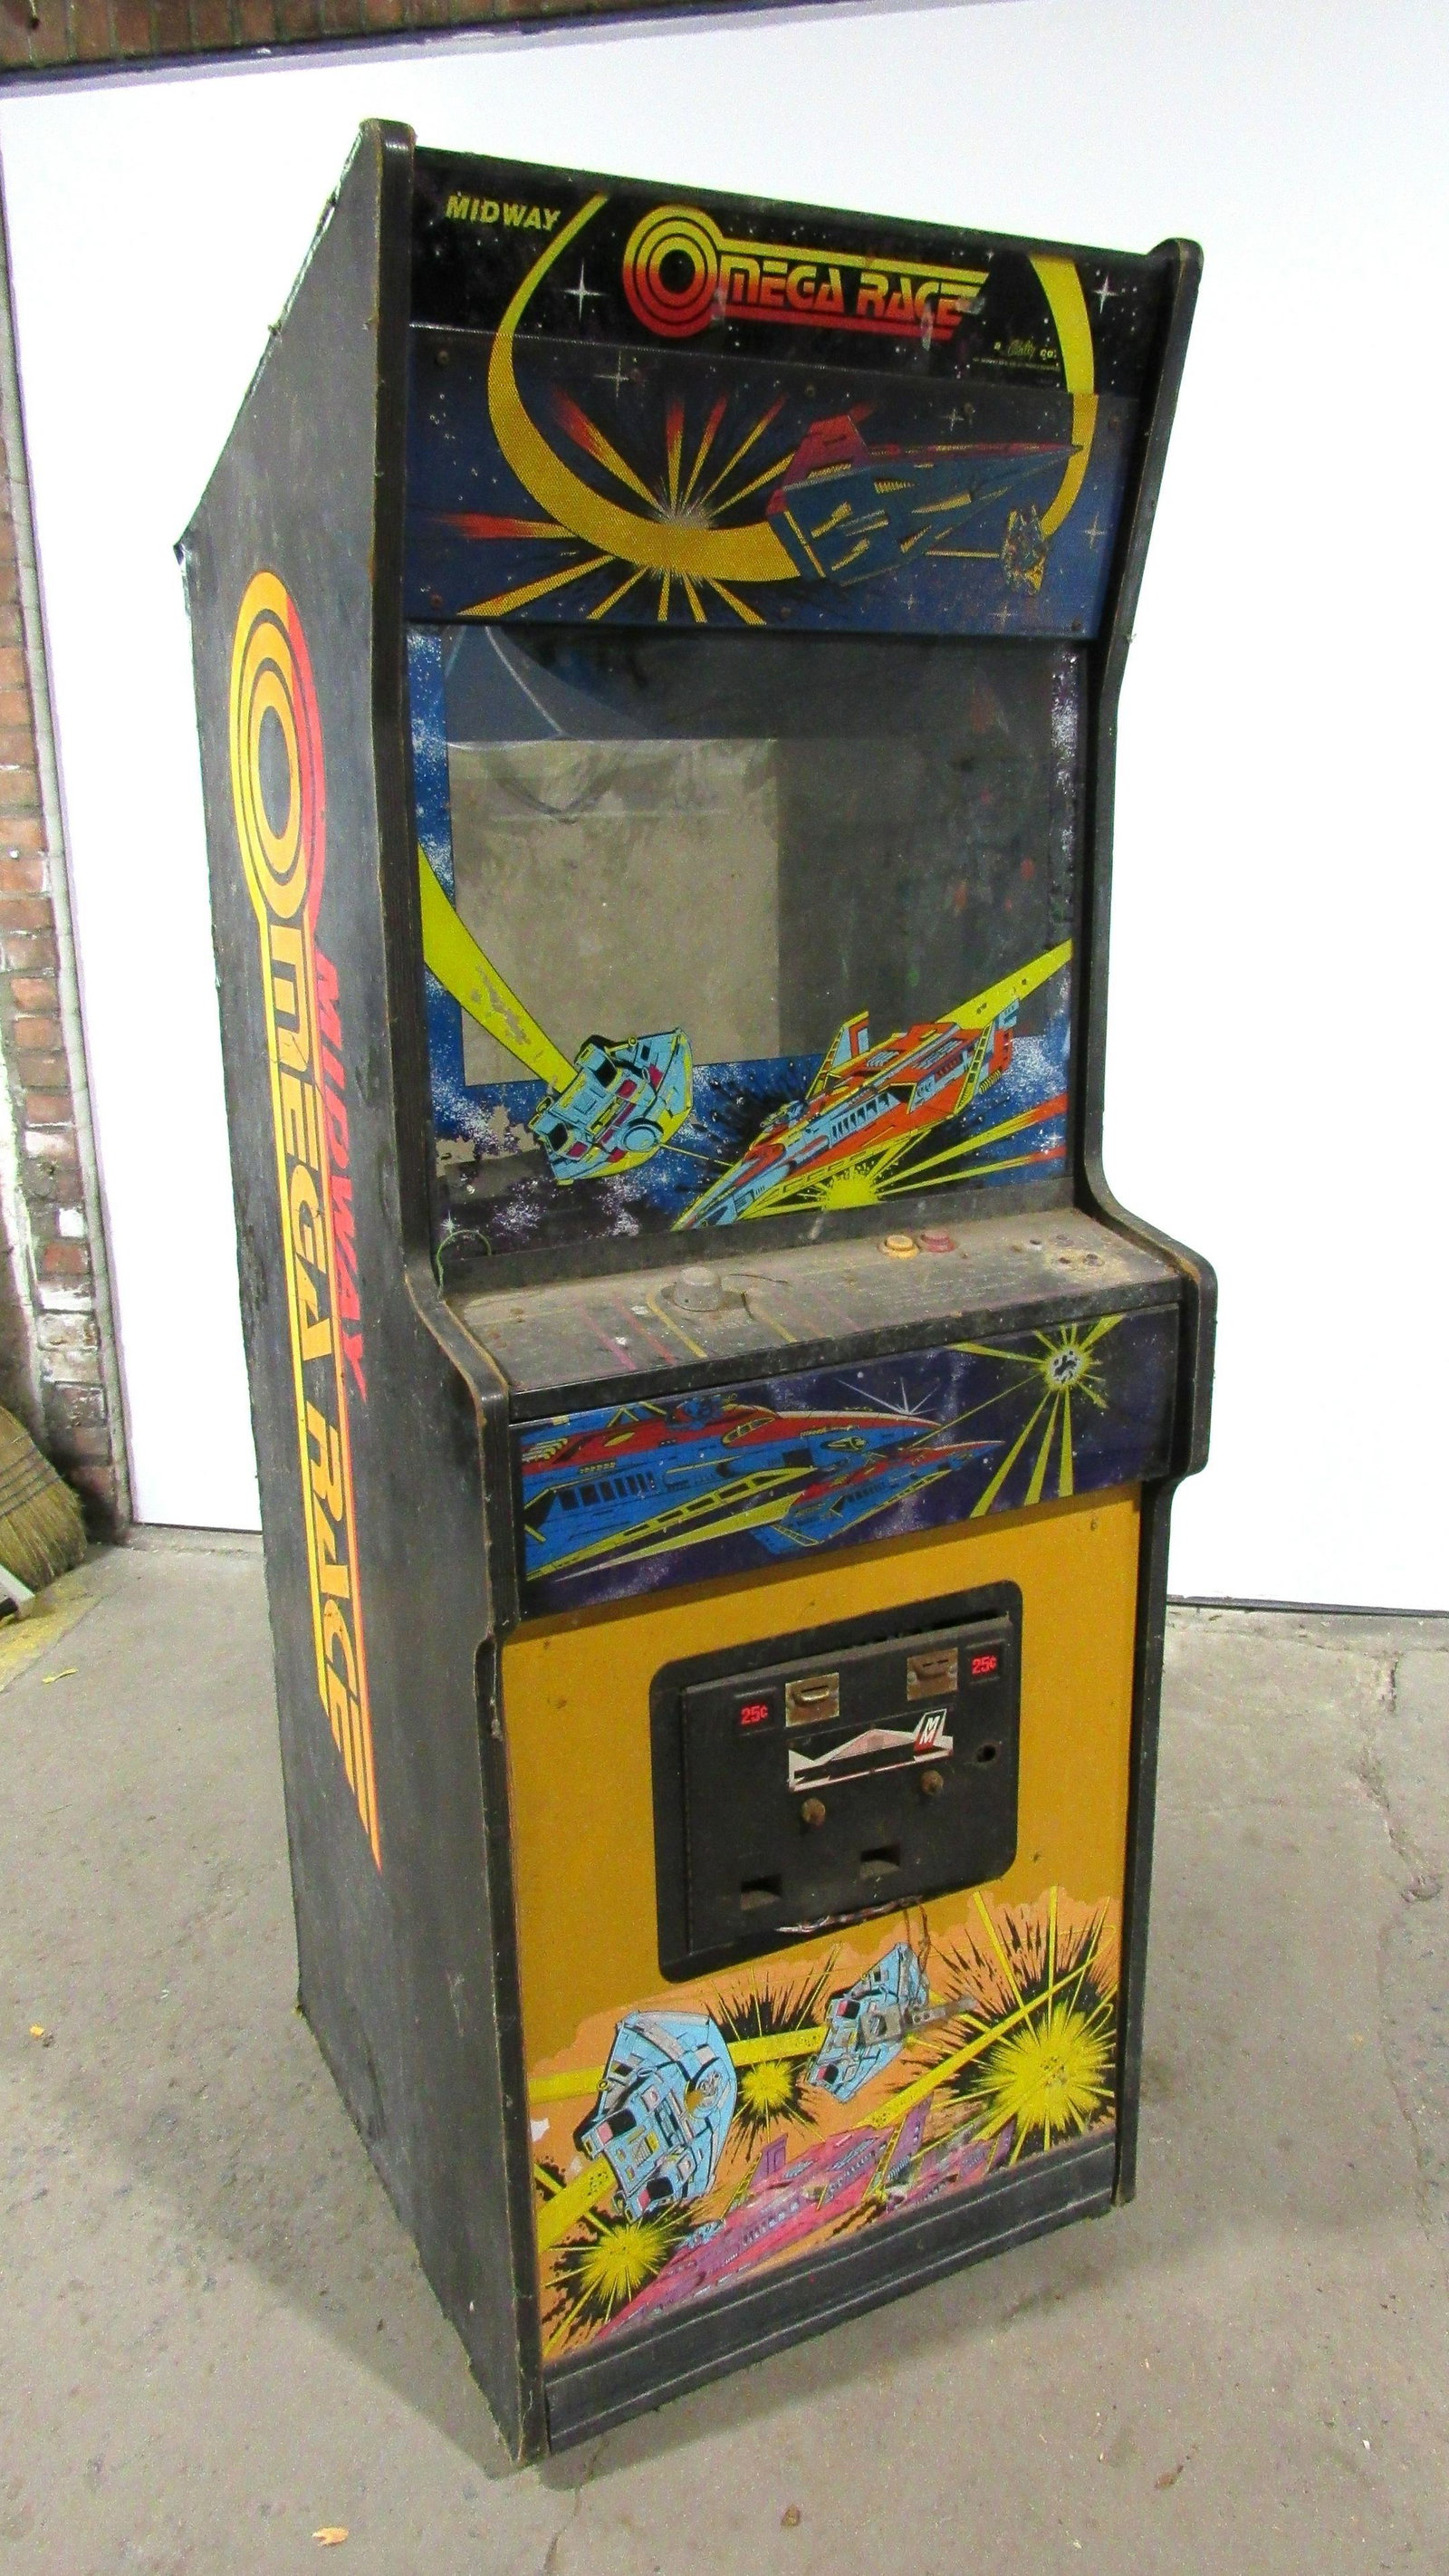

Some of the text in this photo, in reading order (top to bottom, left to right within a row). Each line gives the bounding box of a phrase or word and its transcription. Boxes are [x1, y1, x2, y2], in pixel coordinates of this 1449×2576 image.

[445, 194, 561, 232] MIDWAY
[621, 204, 983, 340] OMEGA RACE
[228, 570, 369, 1835] OMEGA RACE
[316, 950, 368, 1402] MIDWAY
